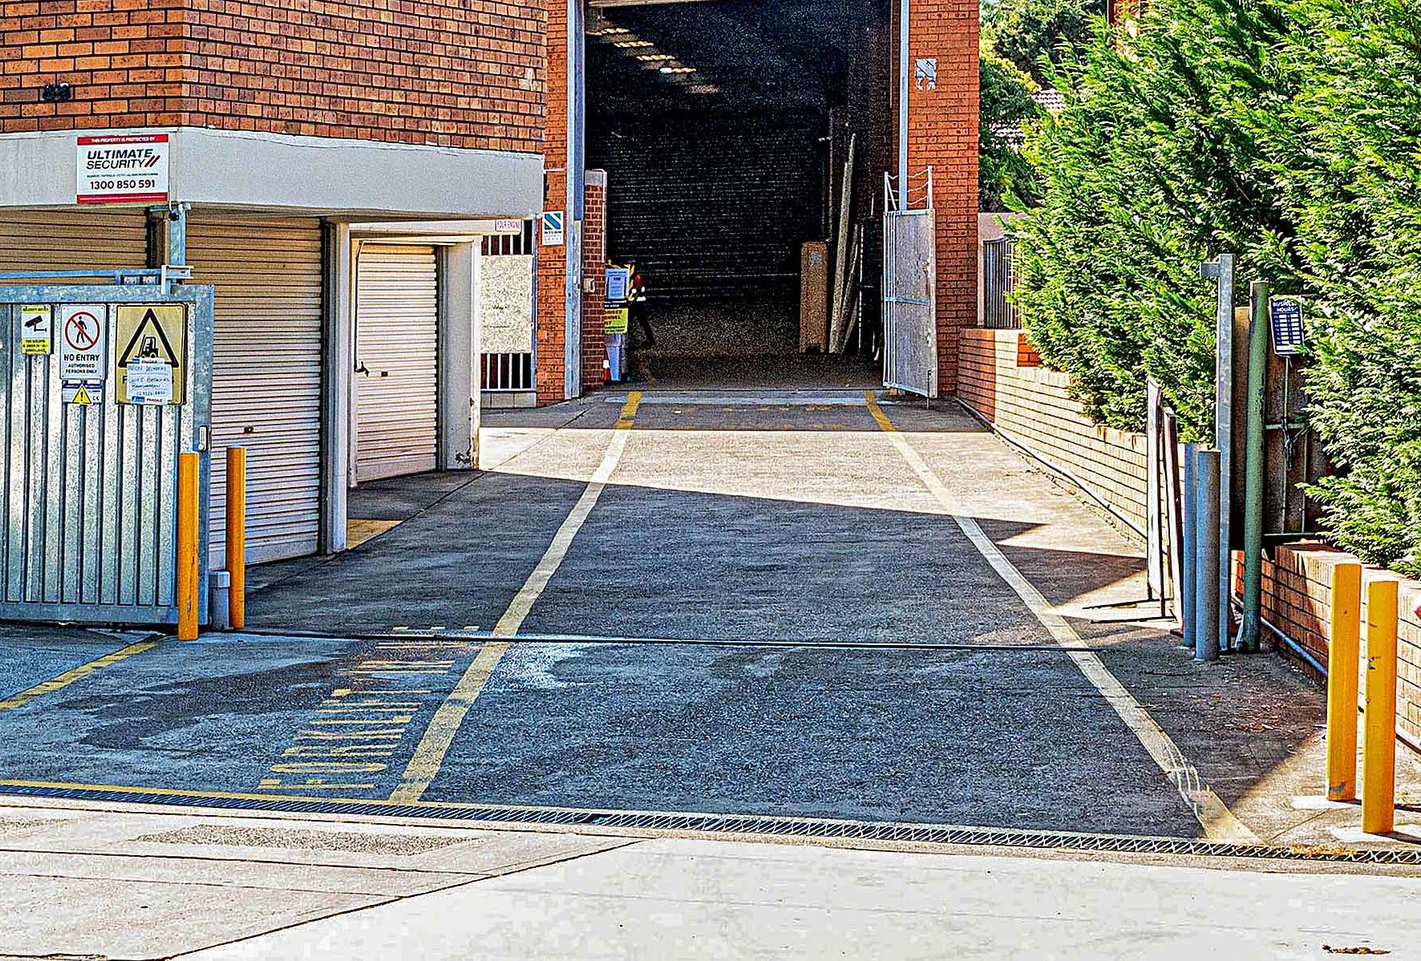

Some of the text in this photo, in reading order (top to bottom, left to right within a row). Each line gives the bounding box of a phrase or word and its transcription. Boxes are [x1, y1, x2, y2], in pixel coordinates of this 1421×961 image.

[87, 148, 154, 160] ULTIMATE
[86, 158, 146, 169] SECURITY
[90, 179, 155, 190] 1300 850 591
[76, 353, 100, 361] ENTRY
